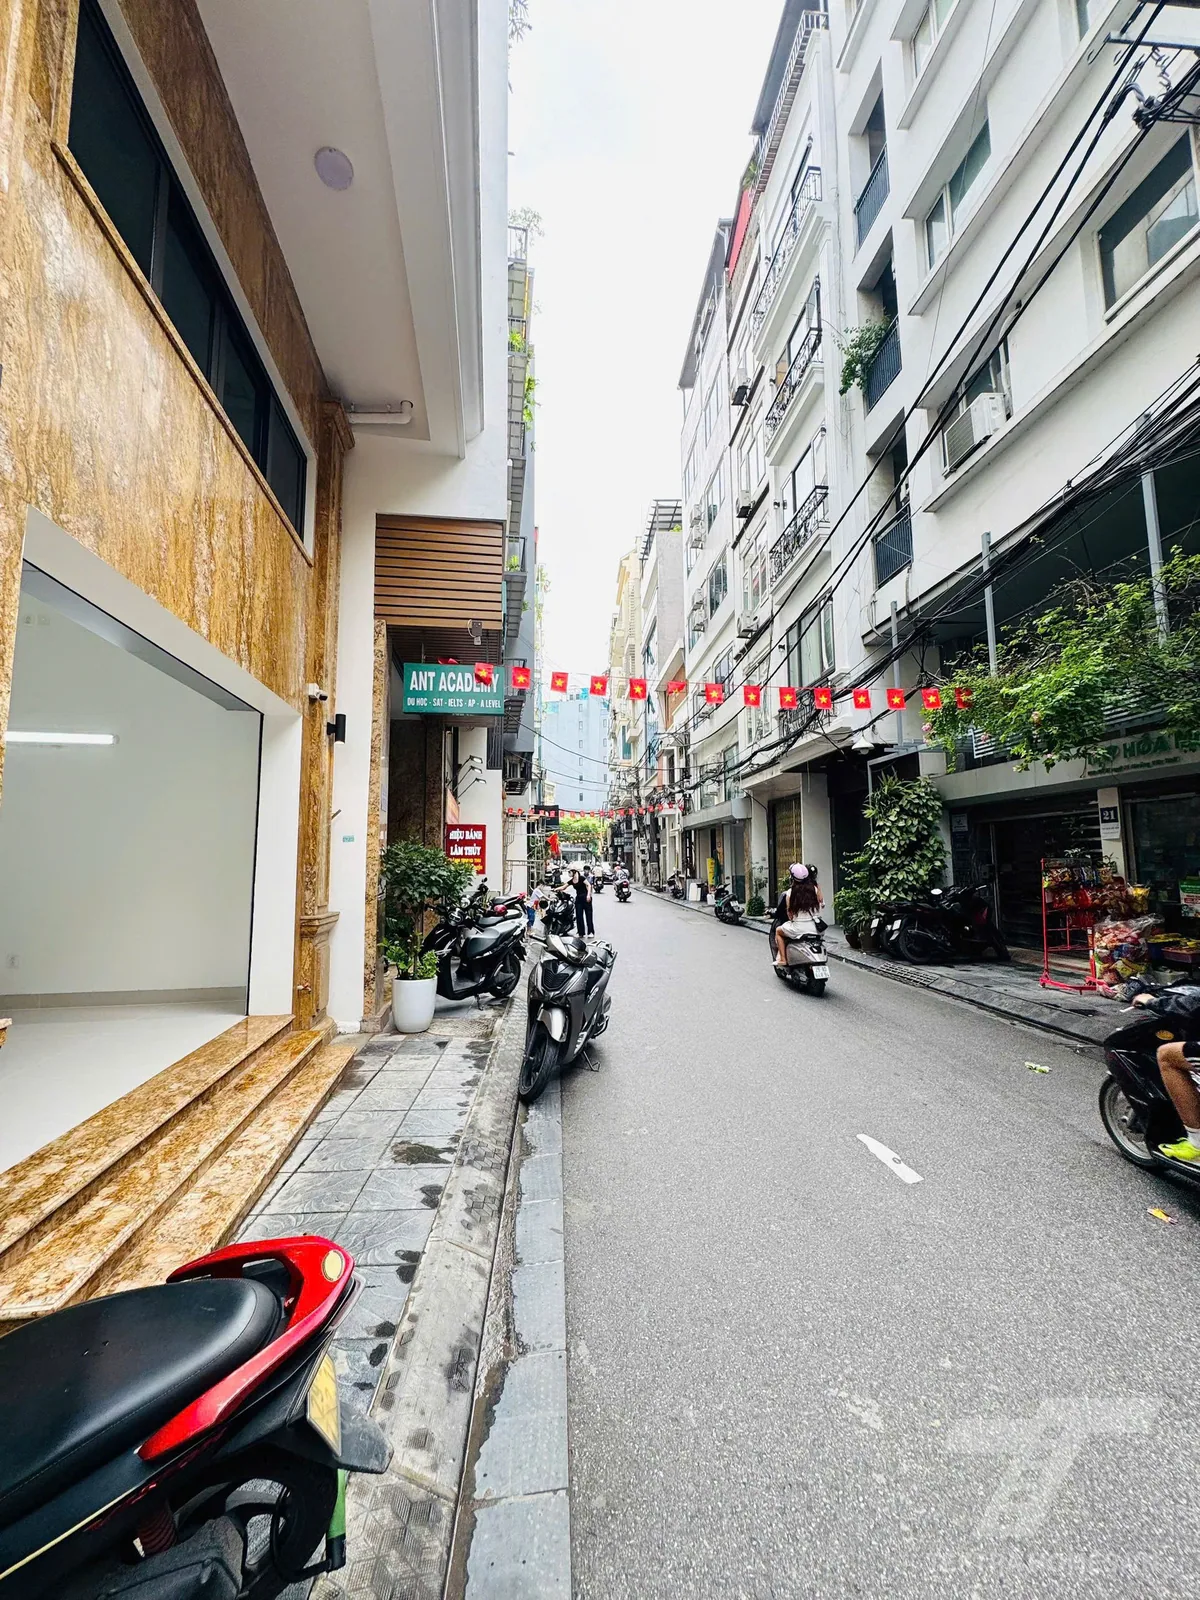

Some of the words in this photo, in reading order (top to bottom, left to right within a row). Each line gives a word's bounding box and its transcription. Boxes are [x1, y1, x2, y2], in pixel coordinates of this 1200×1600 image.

[410, 671, 435, 691] ANT
[433, 698, 443, 706] SAT
[448, 699, 463, 707] IELTS
[468, 699, 476, 707] AP
[480, 699, 485, 708] A
[486, 700, 501, 708] LEVEL
[1103, 810, 1116, 820] 21
